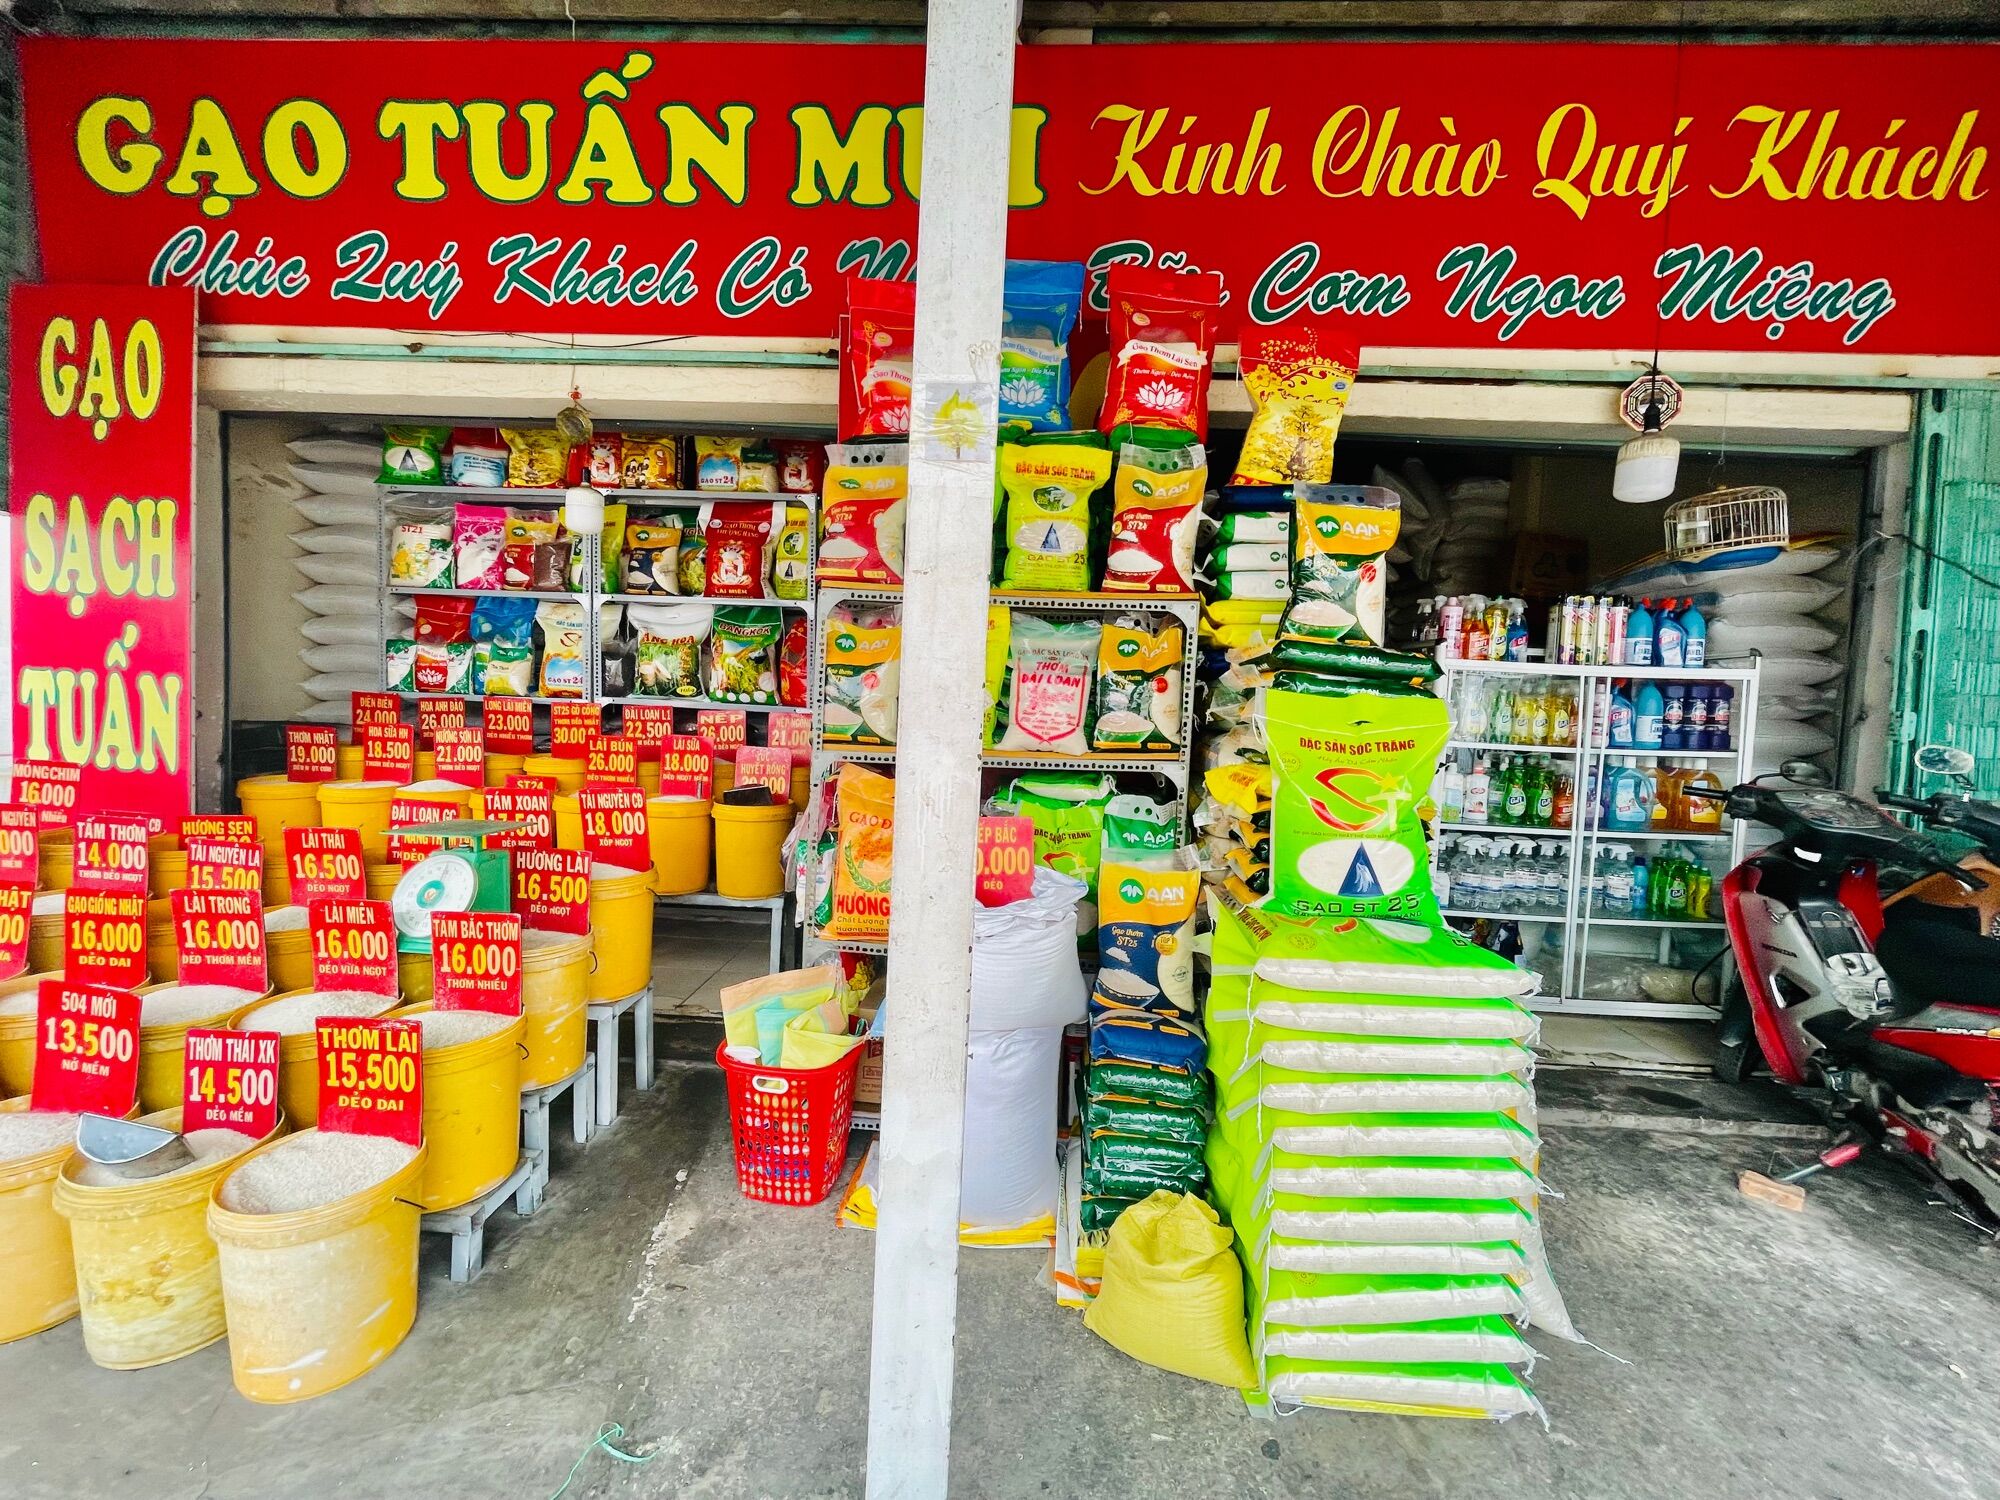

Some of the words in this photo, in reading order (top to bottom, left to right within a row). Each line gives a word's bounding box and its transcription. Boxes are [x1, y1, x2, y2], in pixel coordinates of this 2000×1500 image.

[76, 96, 348, 217] GẠO
[377, 50, 755, 207] TUẤN
[788, 103, 1048, 208] MI
[1078, 103, 1286, 197] Kính
[1311, 103, 1508, 198] Chào
[1532, 103, 1694, 221] Quý
[1709, 105, 1989, 202] Khách
[149, 225, 311, 298] Chúc
[332, 229, 463, 320] Quý
[487, 233, 700, 307] Khách
[716, 235, 812, 319] Có
[1248, 240, 1411, 326] Cơm
[1435, 242, 1626, 342] Ngon
[1655, 242, 1897, 346] Miệng
[39, 316, 163, 441] GẠO
[1154, 482, 1190, 497] AAN
[1342, 519, 1380, 535] AAN
[24, 494, 177, 617] SẠCH
[719, 623, 772, 636] BANGKOK
[1022, 671, 1043, 684] ĐÀI
[1047, 674, 1081, 688] LOAN
[20, 624, 181, 775] TUẤN
[422, 714, 464, 730] 26.000
[488, 714, 529, 731] 23.000
[625, 707, 638, 719] ĐÀI
[641, 709, 659, 720] LOAN
[700, 725, 744, 741] 26.000
[290, 745, 336, 764] 19.000
[367, 740, 410, 760] 18.500
[436, 745, 482, 763] 21.000
[611, 740, 633, 752] BÚN
[1299, 736, 1322, 753] ĐẶC
[1324, 738, 1347, 755] SẢN
[1374, 738, 1415, 753] TRĂNG
[589, 752, 634, 773] 26.000
[664, 754, 709, 773] 18.000
[19, 780, 75, 808] 16.000
[517, 780, 544, 789] ST24
[486, 791, 512, 810] TÁM
[515, 796, 548, 811] XOAN
[581, 790, 595, 809] TÀI
[598, 789, 630, 809] NGUYÊN
[392, 801, 410, 821] ĐÀI
[413, 807, 439, 823] LOAN
[77, 816, 105, 840] TẤM
[110, 824, 146, 843] THƠM
[182, 819, 224, 835] HƯƠNG
[228, 822, 252, 835] SEN
[585, 811, 645, 836] 18.000
[995, 822, 1017, 843] BẮC
[302, 832, 318, 849] LÀI
[320, 829, 345, 849] THÁI
[1143, 829, 1175, 844] AAN
[78, 842, 146, 870] 14.000
[191, 841, 206, 861] TÀI
[209, 843, 246, 866] NGUYÊN
[403, 848, 425, 861] DẺO
[517, 850, 562, 872] HƯƠNG
[566, 852, 588, 874] LÀI
[293, 853, 360, 880] 16.500
[191, 865, 259, 889] 15.500
[307, 882, 326, 893] DẺO
[328, 884, 351, 895] NGỌT
[517, 872, 588, 904] 16.500
[1146, 885, 1185, 901] AAN
[118, 895, 144, 920] NHẬT
[184, 891, 206, 914] LÀI
[531, 902, 547, 914] DẺO
[836, 892, 890, 917] HƯƠNG
[1353, 903, 1380, 913] ST
[1388, 893, 1420, 909] 25
[324, 904, 344, 923] LÀI
[71, 920, 142, 953] 16.000
[182, 920, 259, 950] 16.000
[433, 916, 457, 938] TÁM
[460, 914, 483, 939] BẮC
[486, 919, 518, 941] THƠM
[1112, 926, 1125, 936] Gạo
[1126, 929, 1144, 938] thơm
[316, 929, 388, 960] 16.000
[1117, 936, 1138, 948] ST25
[79, 954, 105, 966] DẺO
[109, 957, 131, 967] DAI
[206, 955, 234, 965] THƠM
[440, 943, 516, 977] 16.000
[319, 963, 338, 975] DẺO
[341, 963, 361, 975] VỪA
[363, 966, 387, 978] NGỌT
[446, 978, 474, 989] THƠM
[61, 991, 87, 1016] 504
[90, 993, 117, 1018] MỚI
[45, 1017, 133, 1063] 13.500
[318, 1025, 381, 1050] THƠM
[386, 1026, 418, 1054] LÀI
[188, 1036, 223, 1063] THƠM
[226, 1038, 255, 1063] THÁI
[258, 1040, 276, 1064] XK
[326, 1052, 417, 1093] 15.500
[189, 1068, 275, 1106] 14.500
[338, 1092, 373, 1108] DẺO
[377, 1098, 404, 1112] DAI
[206, 1105, 227, 1121] DẺO
[230, 1108, 254, 1123] MỀM
